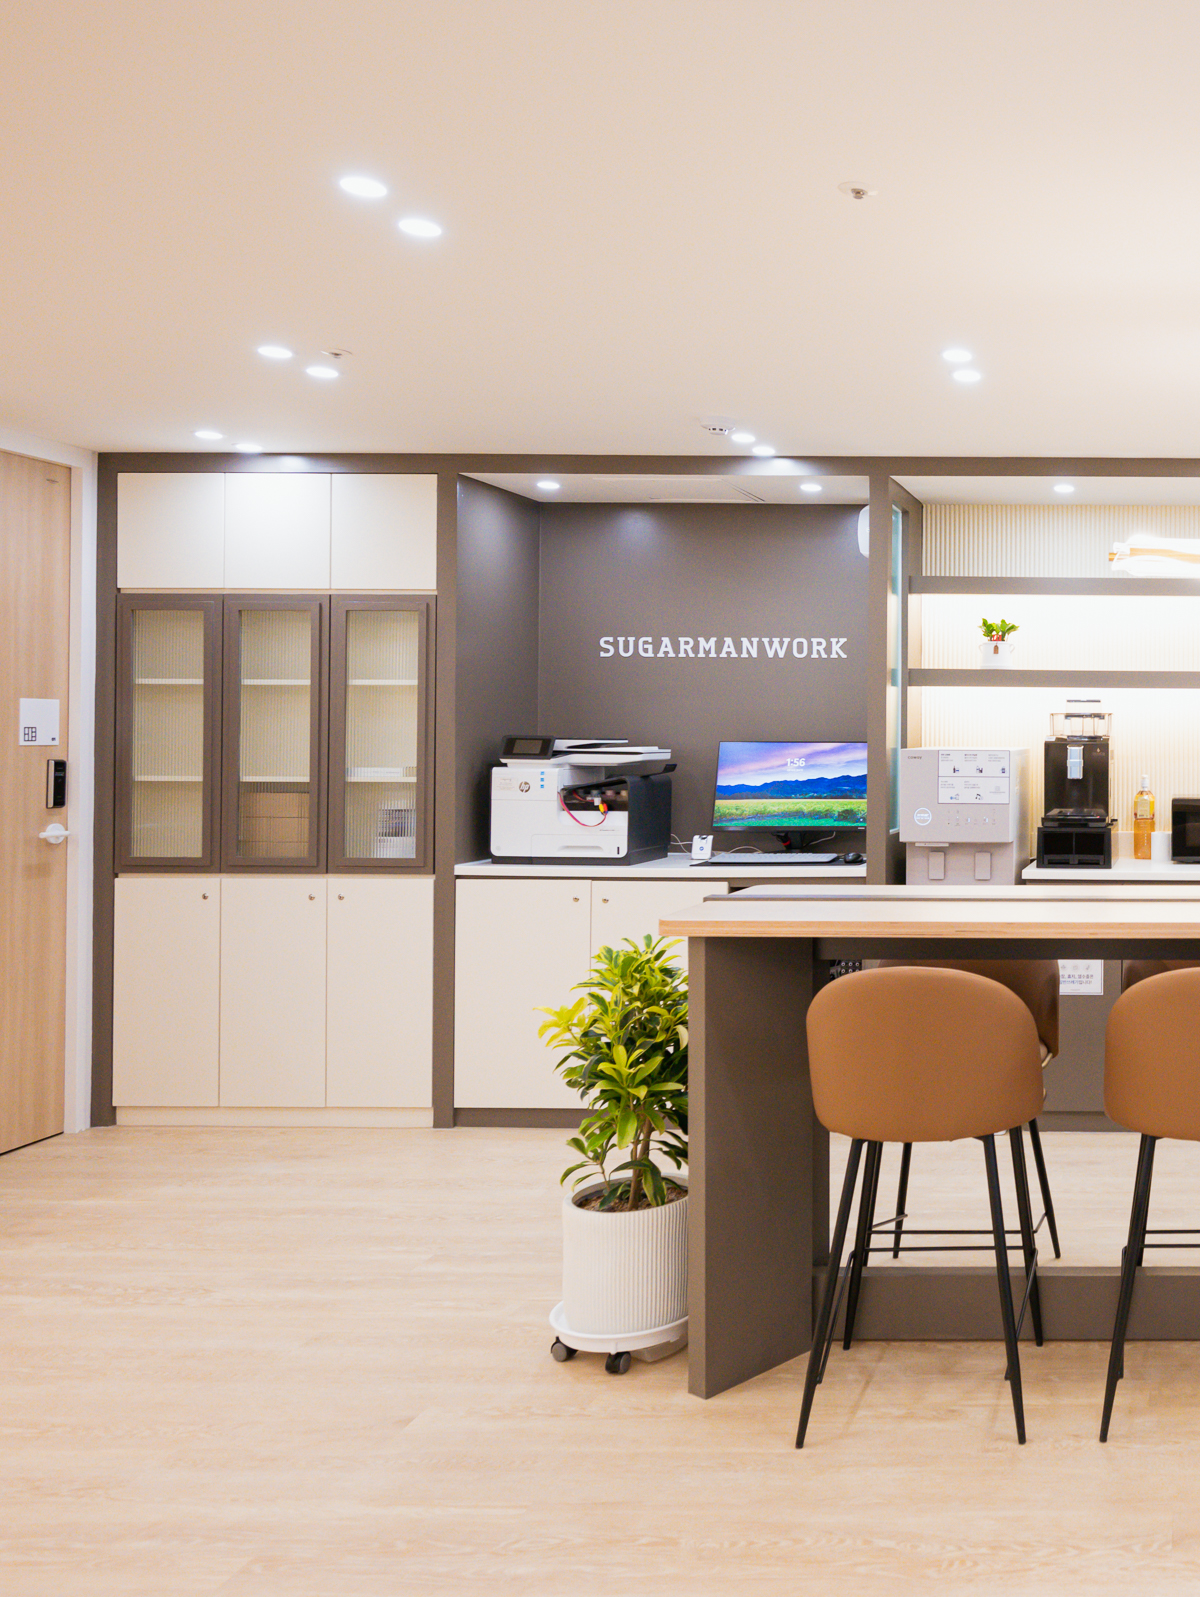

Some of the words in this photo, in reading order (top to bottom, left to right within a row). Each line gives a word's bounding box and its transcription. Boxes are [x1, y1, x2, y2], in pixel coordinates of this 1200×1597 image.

[599, 636, 848, 659] SUGARMANWORK
[786, 758, 806, 767] 1:56
[519, 781, 530, 793] hp
